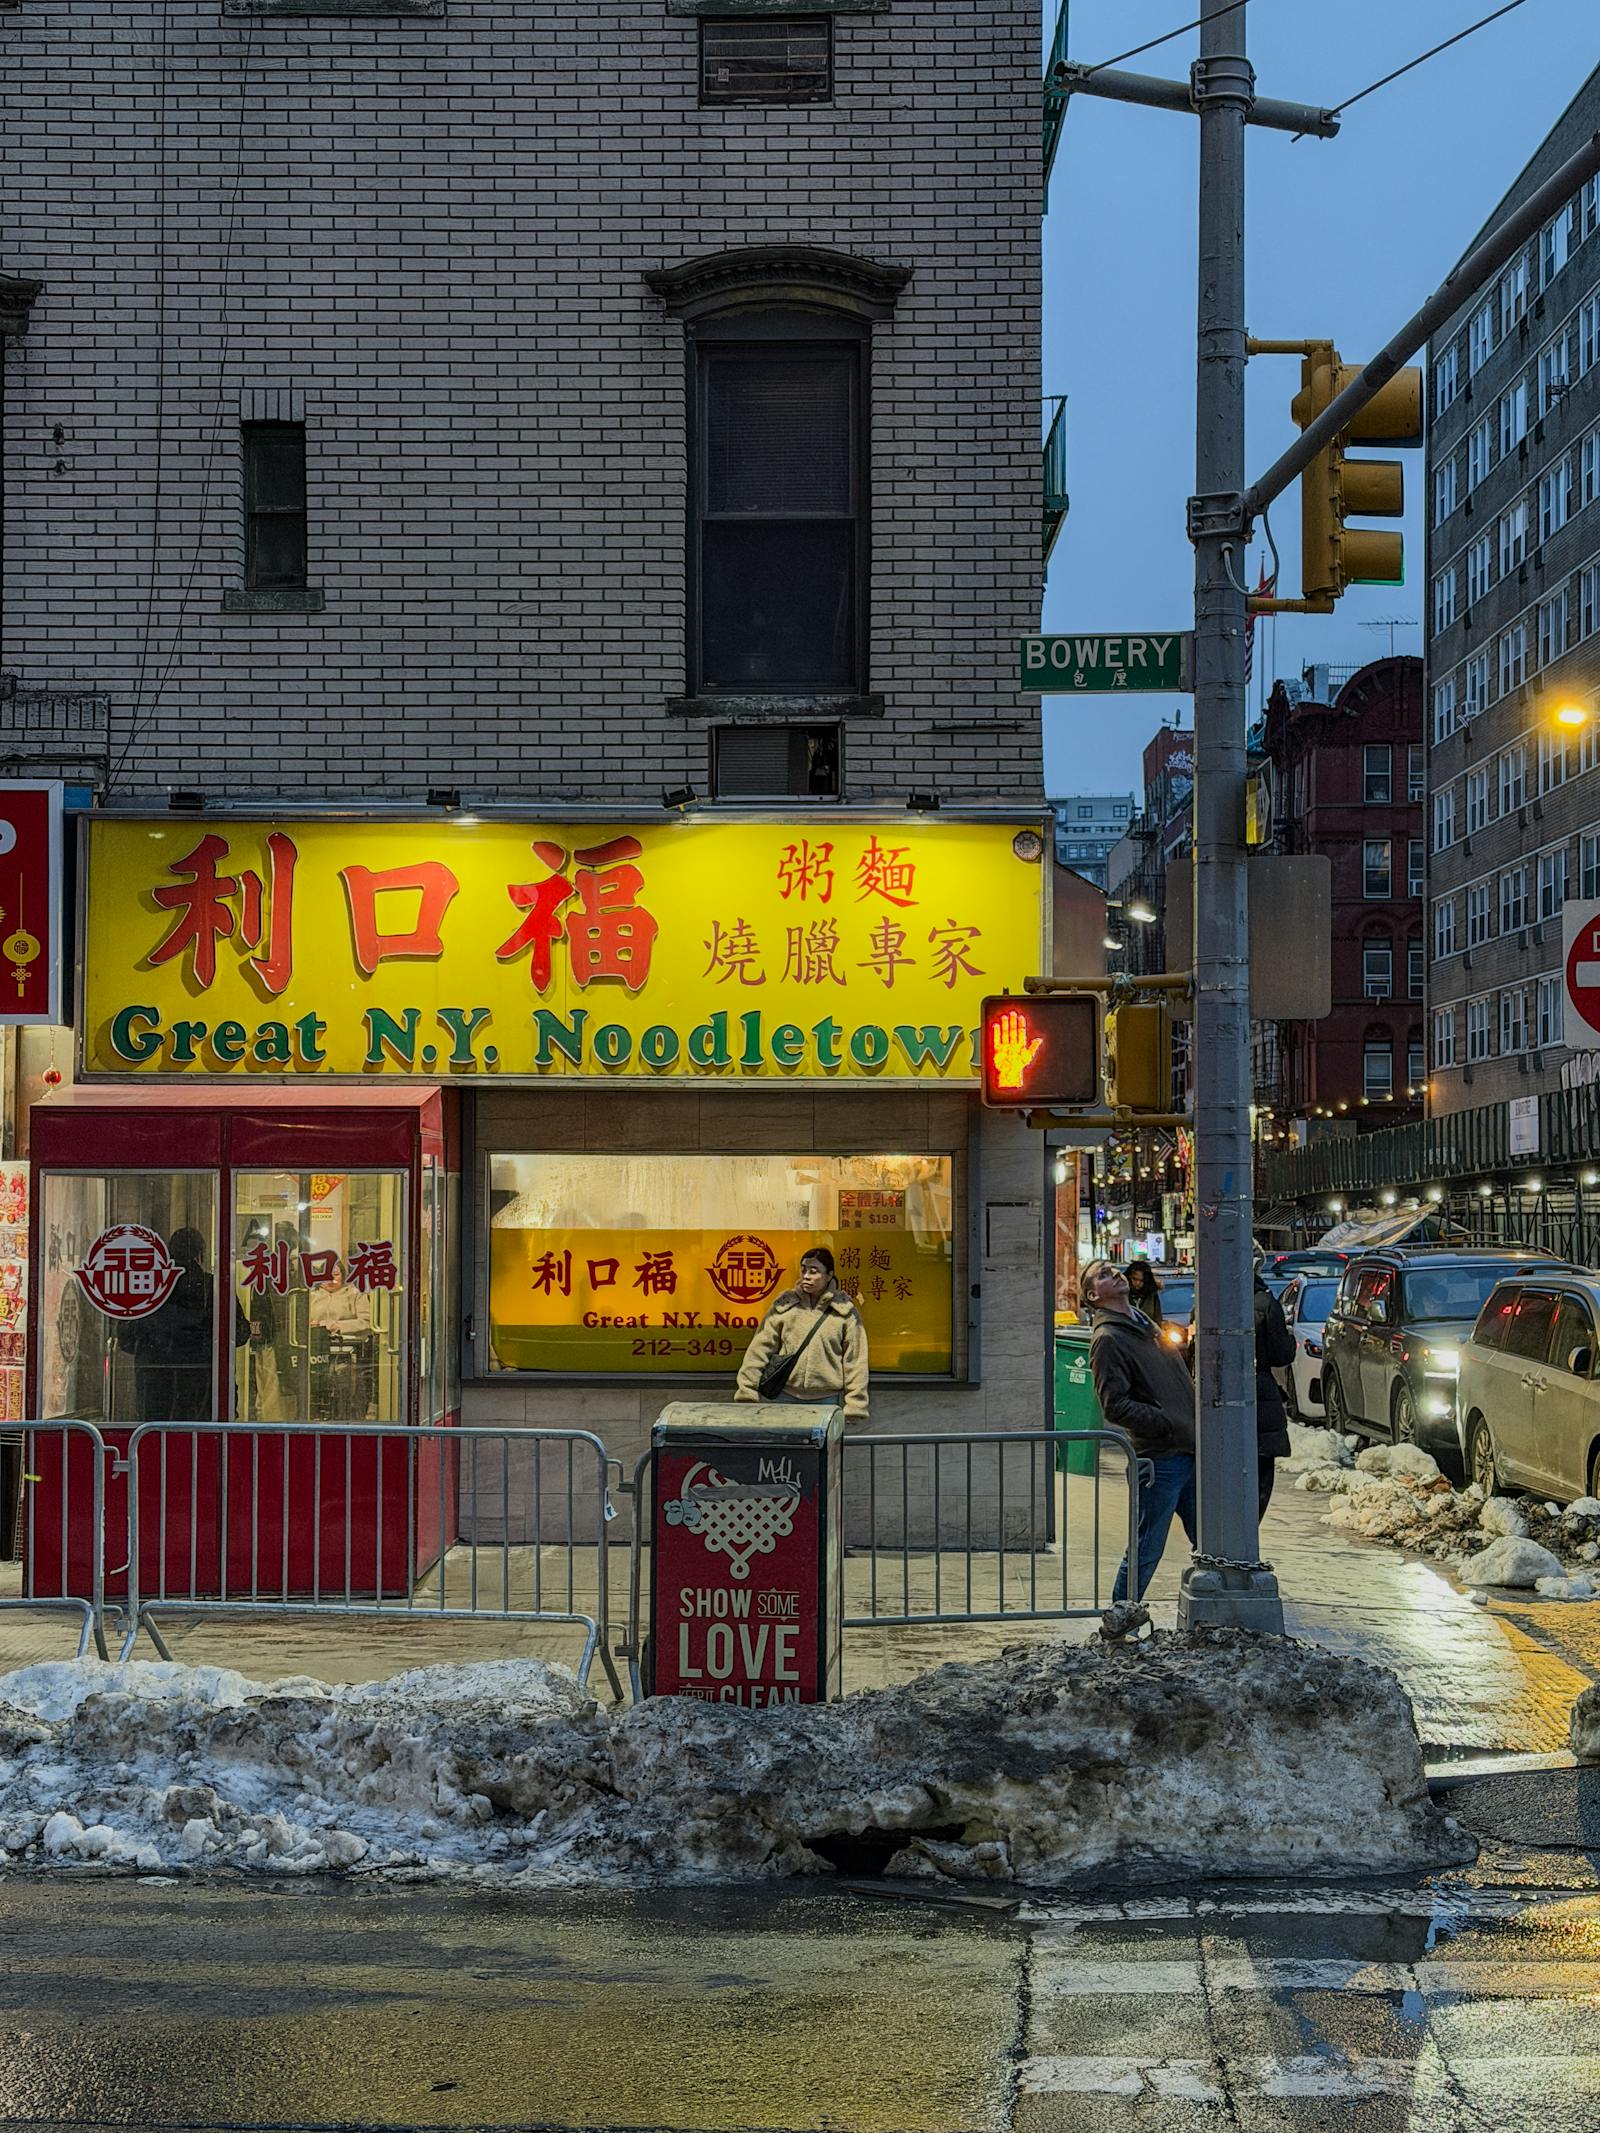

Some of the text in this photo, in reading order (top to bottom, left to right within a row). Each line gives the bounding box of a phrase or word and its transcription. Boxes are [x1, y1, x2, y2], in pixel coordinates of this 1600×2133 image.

[1026, 638, 1173, 669] BOWERY
[1073, 669, 1128, 687] 包厘
[777, 835, 920, 908] 粥麵
[148, 832, 659, 994] 利口福
[702, 916, 987, 990] 燒臘專家
[110, 1005, 982, 1067] Great N.Y. Noodletow
[868, 1213, 897, 1225] $198
[241, 1240, 399, 1297] 利口福
[531, 1249, 679, 1297] 利口福
[839, 1245, 893, 1271] 粥麵
[839, 1275, 913, 1302] 臘專家
[582, 1311, 760, 1329] Great N.Y. Noo
[631, 1338, 746, 1356] 212-349-
[679, 1587, 800, 1618] SHOW SOME
[678, 1622, 800, 1681] LOVE
